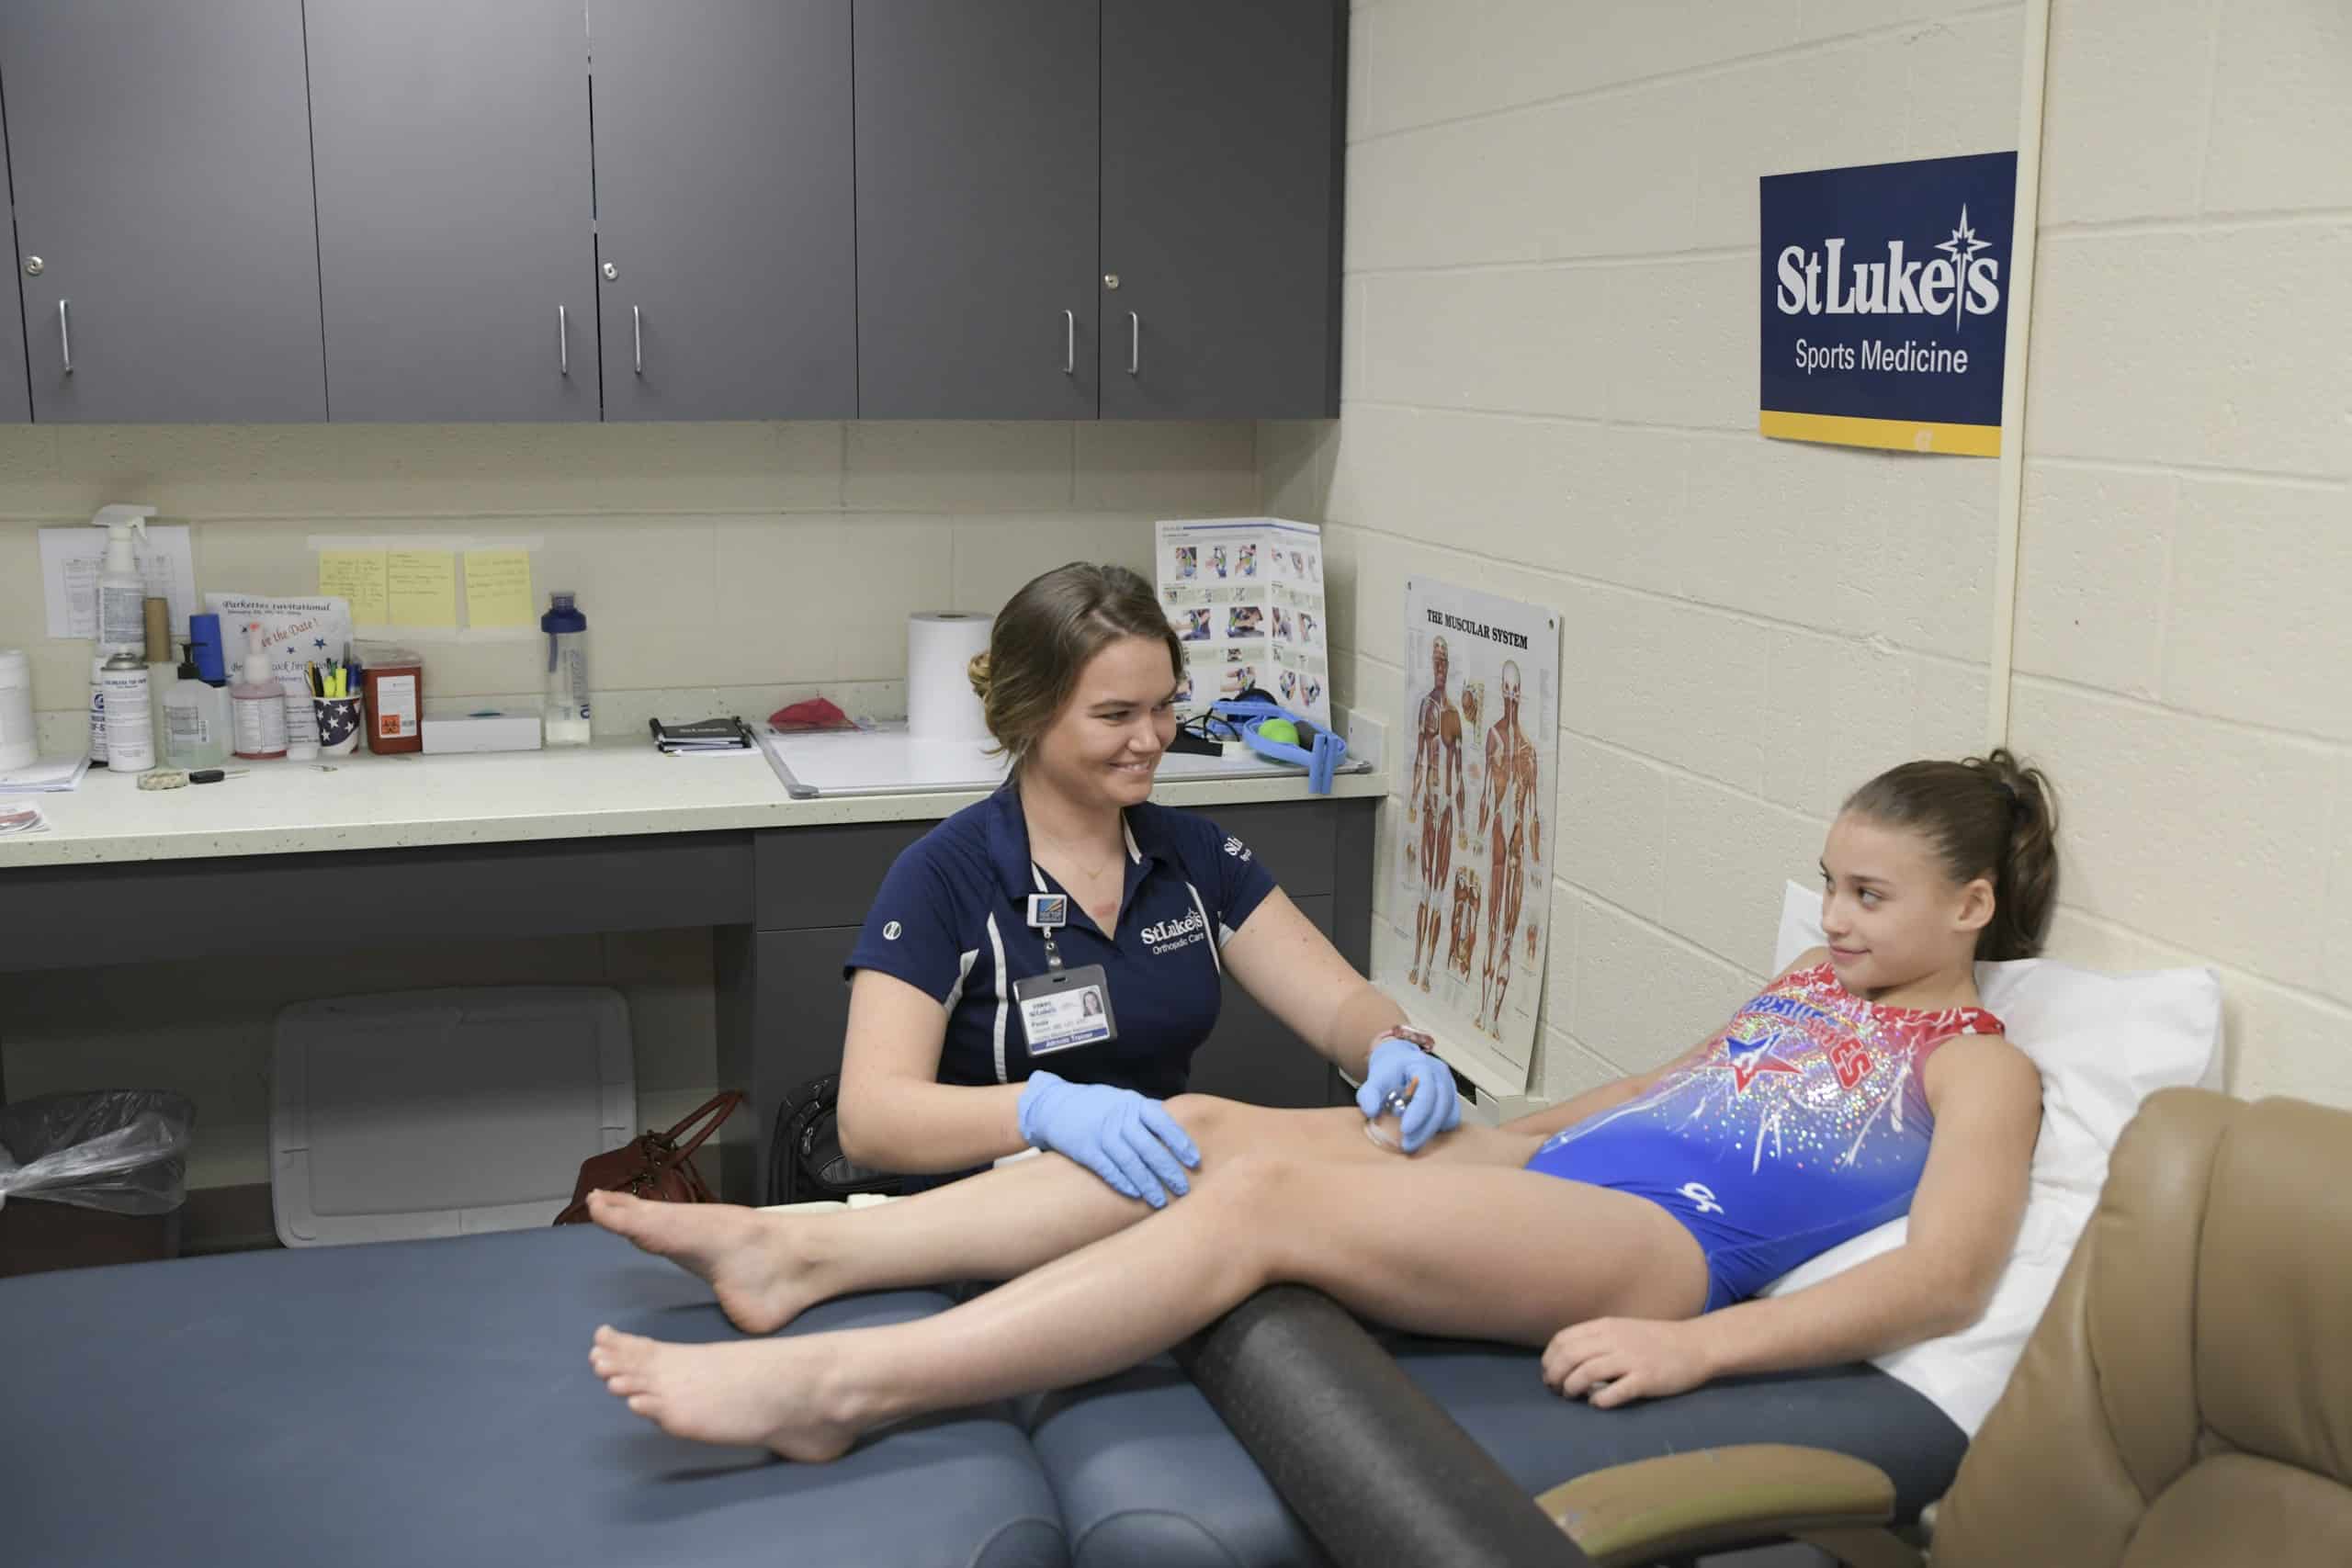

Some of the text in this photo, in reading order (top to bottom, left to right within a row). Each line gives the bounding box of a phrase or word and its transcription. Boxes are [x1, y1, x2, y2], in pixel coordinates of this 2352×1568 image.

[1796, 338, 1969, 375] Sports Medicine
[1427, 609, 1528, 649] THE MUSCULAR SYSTEM
